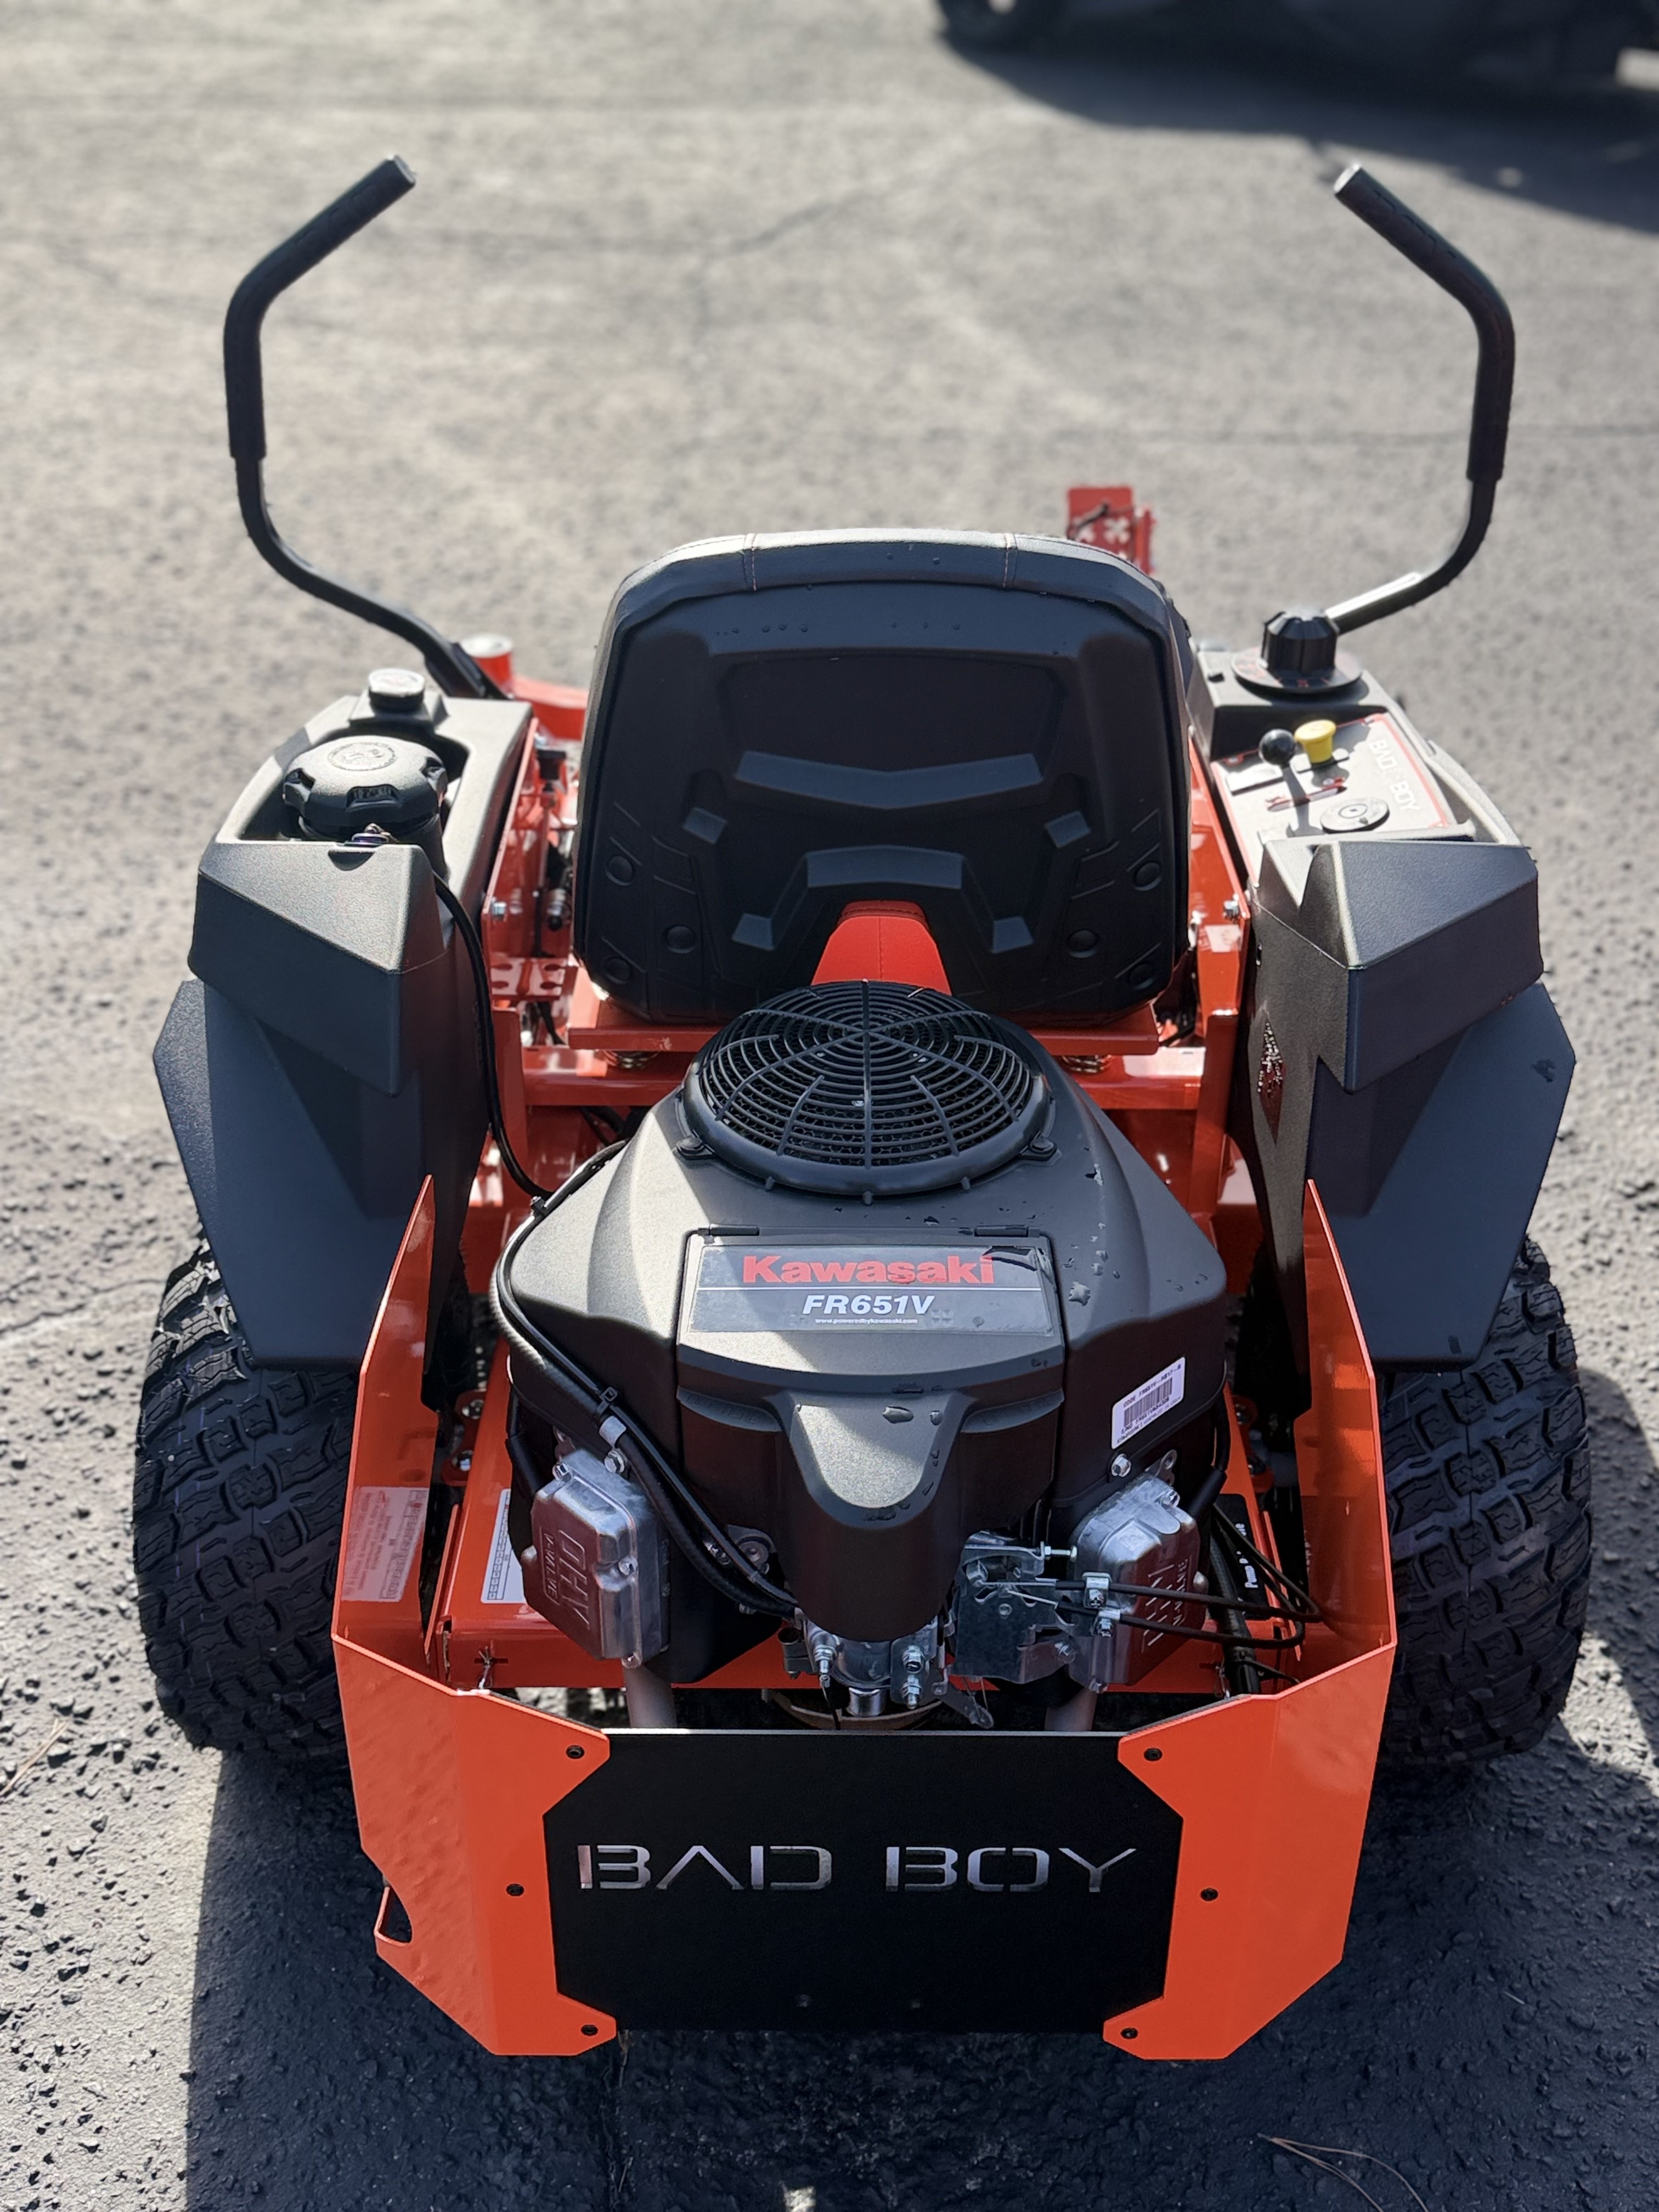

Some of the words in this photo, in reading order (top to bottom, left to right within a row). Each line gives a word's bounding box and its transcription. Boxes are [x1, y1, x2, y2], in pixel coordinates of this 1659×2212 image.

[1369, 740, 1397, 769] BAD
[1389, 781, 1421, 810] BOY
[743, 1255, 994, 1284] Kawasaki
[802, 1294, 935, 1314] FR651V
[558, 1530, 590, 1630] OHV
[1244, 1565, 1259, 1588] Pump
[577, 1844, 832, 1889] BAD
[885, 1846, 1137, 1892] BOY
